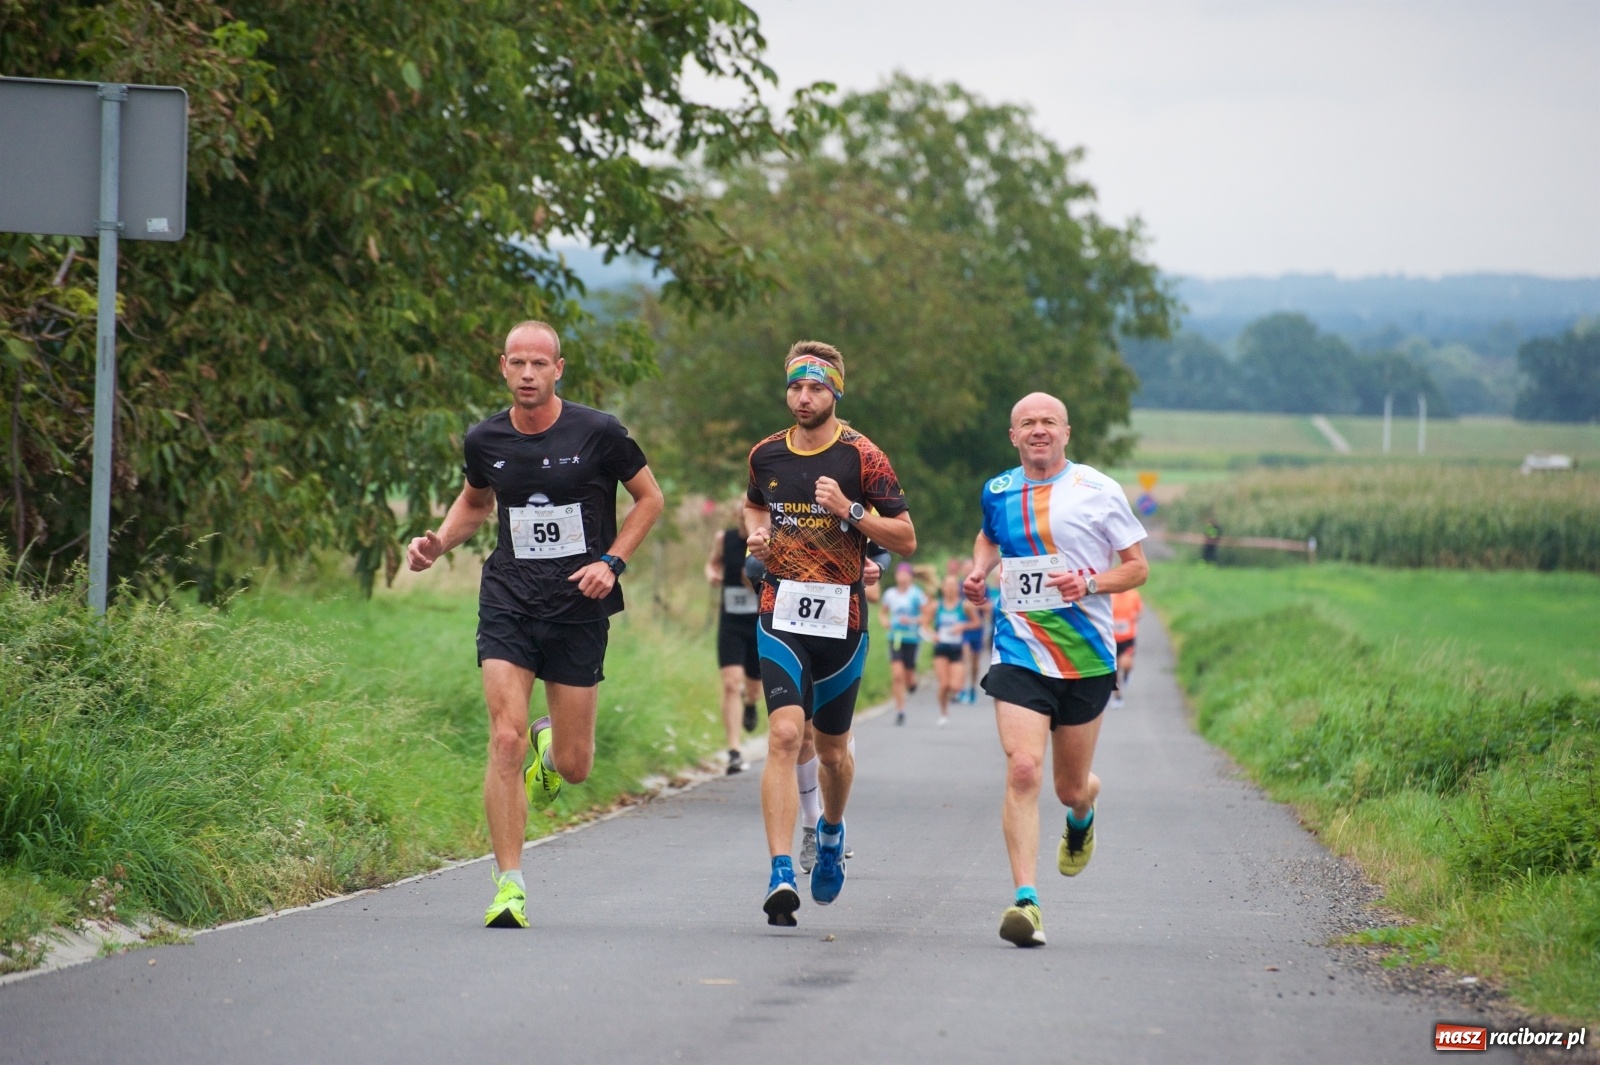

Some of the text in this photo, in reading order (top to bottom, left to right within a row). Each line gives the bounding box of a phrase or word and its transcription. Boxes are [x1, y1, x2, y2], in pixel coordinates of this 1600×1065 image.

[533, 522, 560, 543] 59
[1019, 572, 1043, 595] 37
[798, 597, 826, 619] 87
